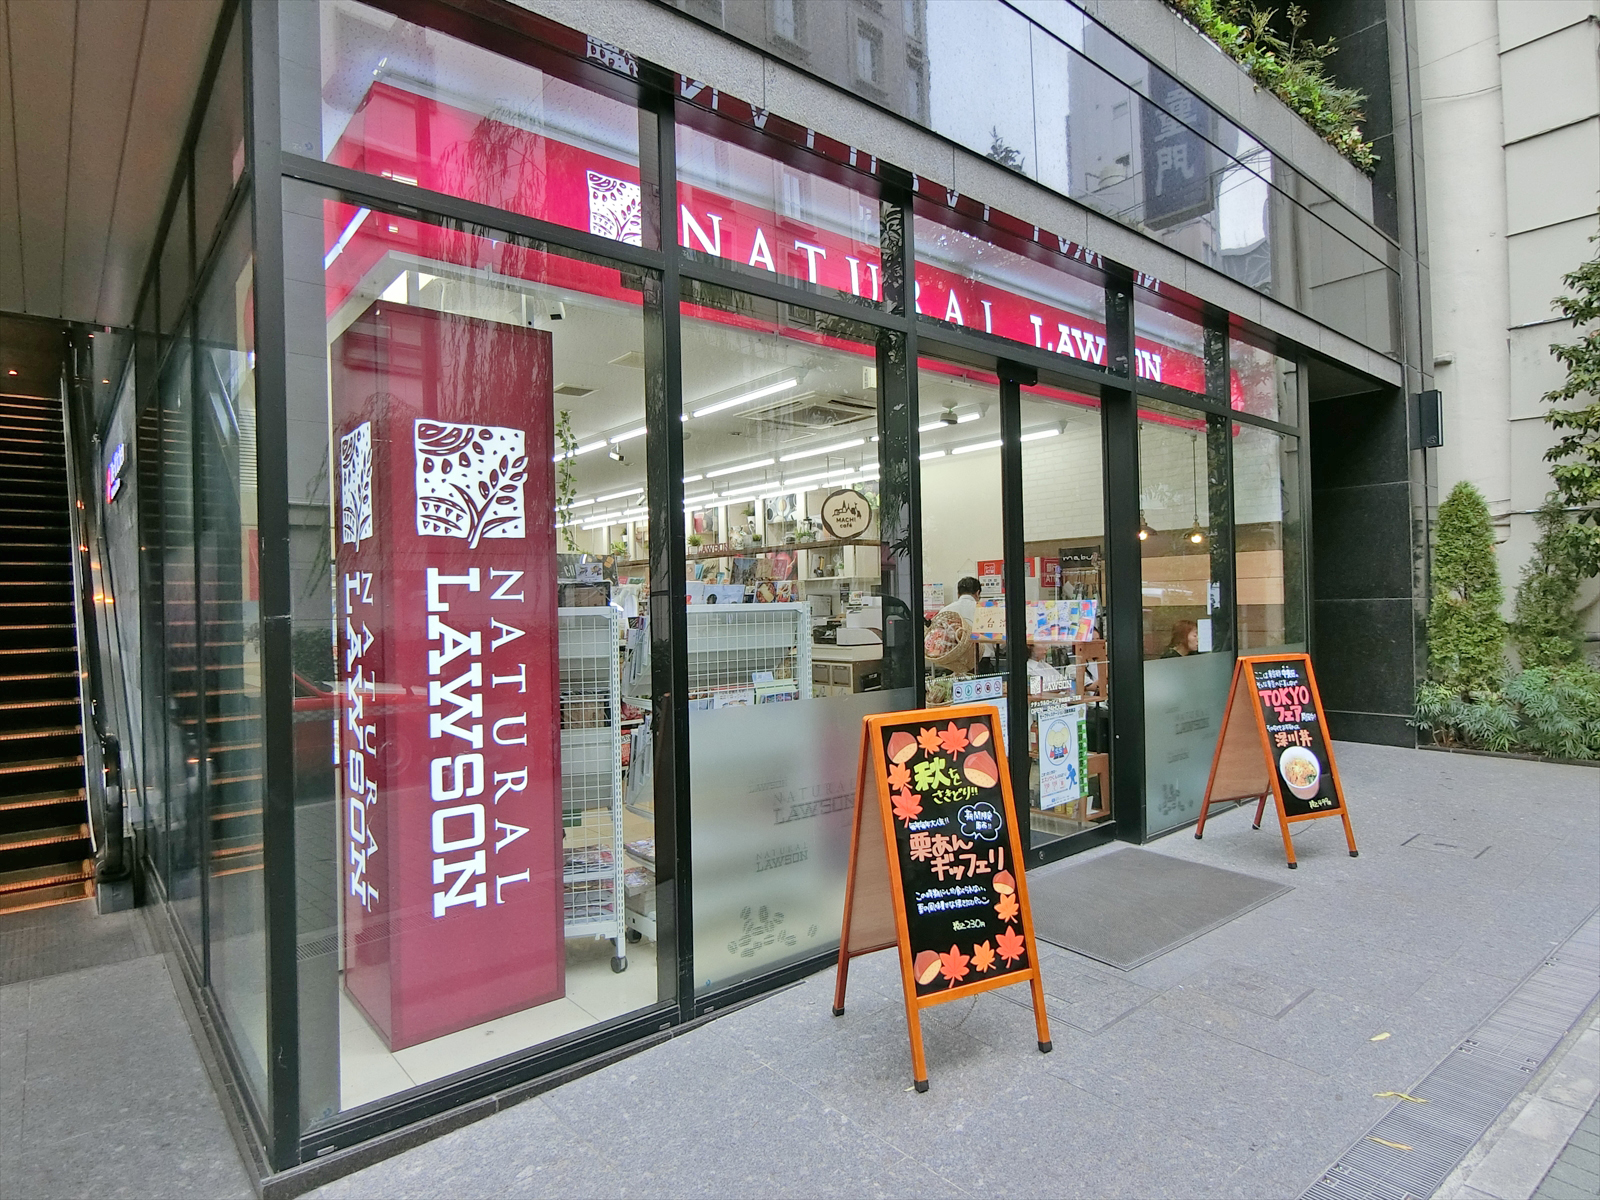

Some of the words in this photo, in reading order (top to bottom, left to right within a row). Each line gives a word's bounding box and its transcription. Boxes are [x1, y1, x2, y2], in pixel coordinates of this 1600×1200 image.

[1030, 314, 1162, 383] LAWN
[1042, 679, 1072, 691] LAWSON
[1259, 686, 1310, 707] TOKYO
[1274, 705, 1302, 723] フェア
[345, 571, 367, 906] LAWSON
[361, 570, 380, 912] NATURAL
[426, 567, 487, 918] LAWSON
[490, 567, 531, 904] NATURAL
[913, 757, 962, 791] 秋を
[756, 850, 808, 873] LAWSON
[909, 831, 974, 862] 栗あん
[930, 846, 1005, 881] ギッフェリ
